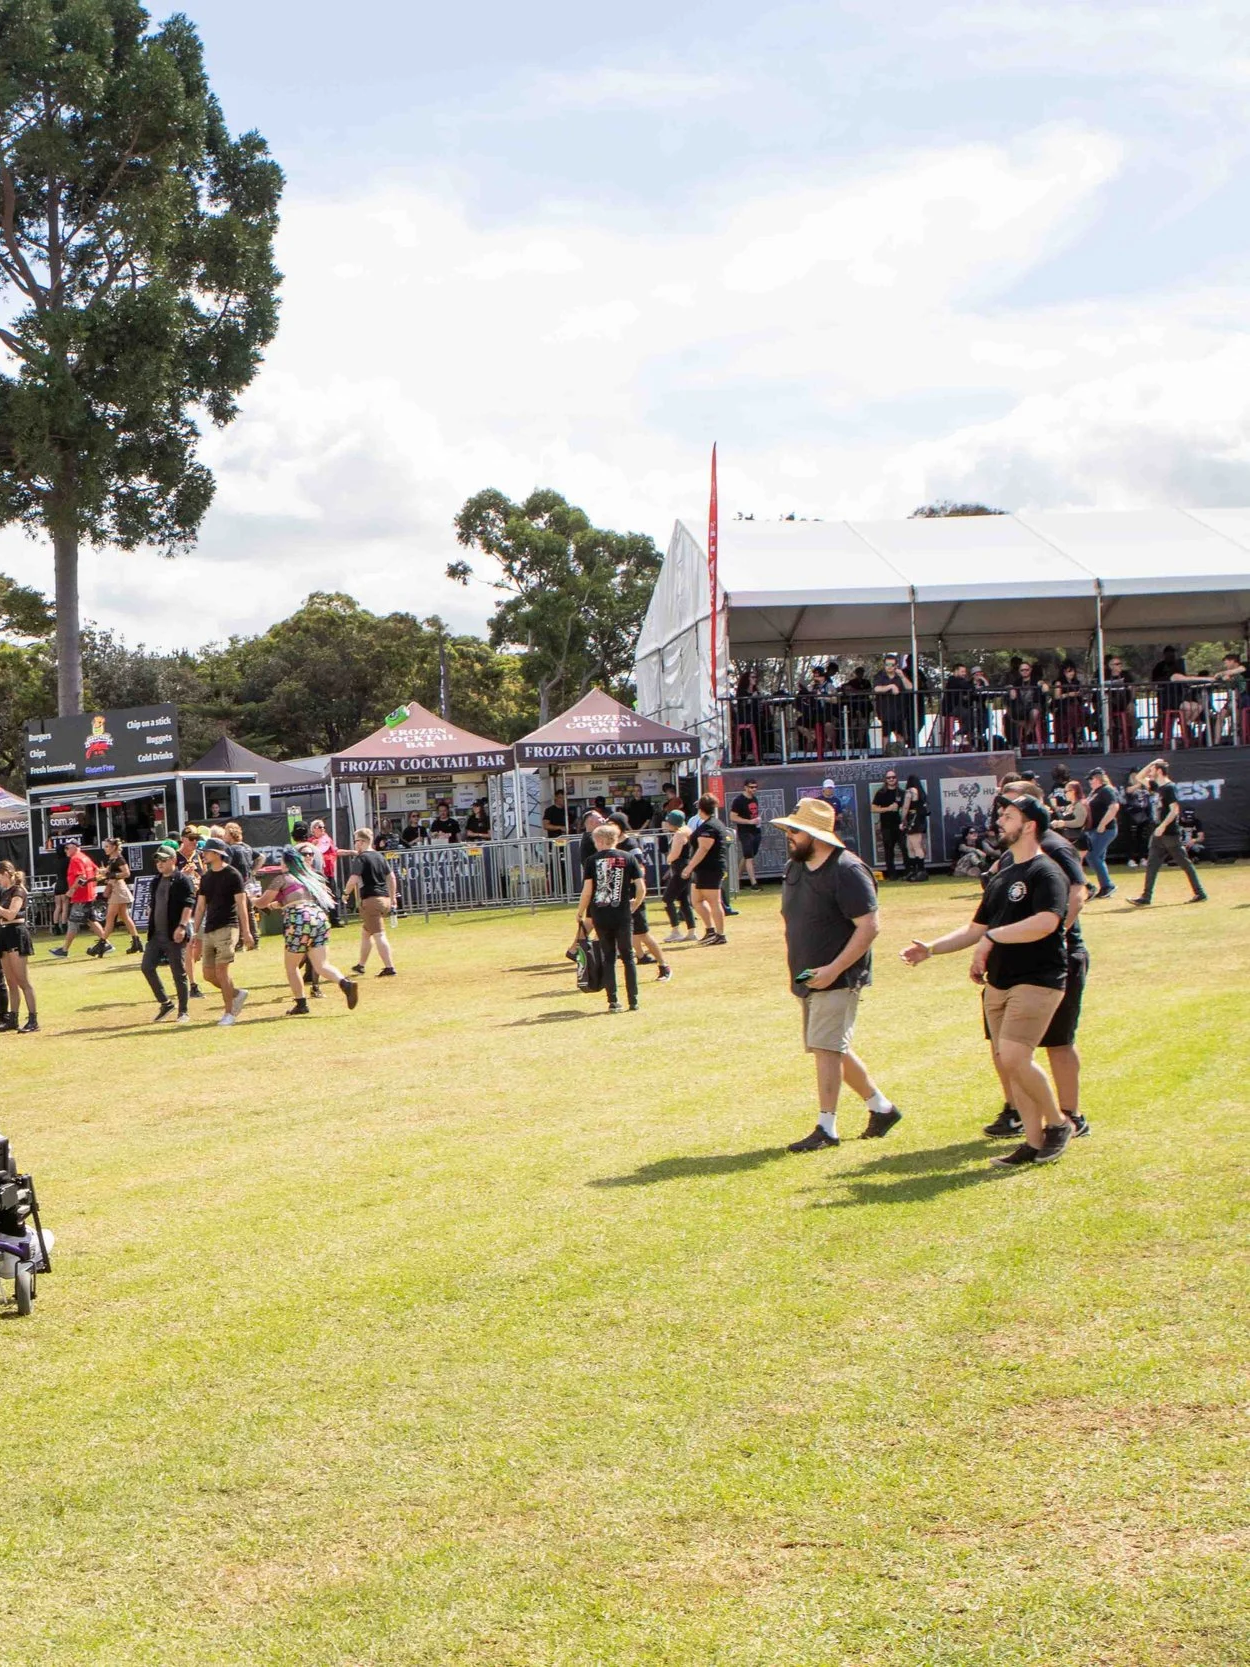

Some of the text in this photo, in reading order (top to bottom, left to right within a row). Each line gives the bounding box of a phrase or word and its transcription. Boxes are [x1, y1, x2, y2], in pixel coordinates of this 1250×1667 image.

[127, 720, 141, 730] Chip
[156, 716, 171, 726] stick
[572, 714, 631, 722] FROZEN
[565, 720, 642, 729] COCKTAIL
[29, 733, 51, 742] Burgers
[389, 727, 447, 737] FROZEN
[146, 734, 172, 745] Nuggets
[381, 734, 458, 744] COCKTAIL
[405, 741, 436, 749] BAR
[525, 741, 692, 758] FROZEN COCKTAIL BAR
[30, 749, 46, 759] Chips
[138, 751, 173, 762] Cold Drinks
[340, 754, 506, 772] FROZEN COCKTAIL BAR
[30, 763, 76, 775] Fresh lemonade
[943, 790, 958, 798] THE
[1176, 778, 1225, 800] EST
[405, 849, 469, 865] FROZEN
[423, 881, 455, 895] BAR
